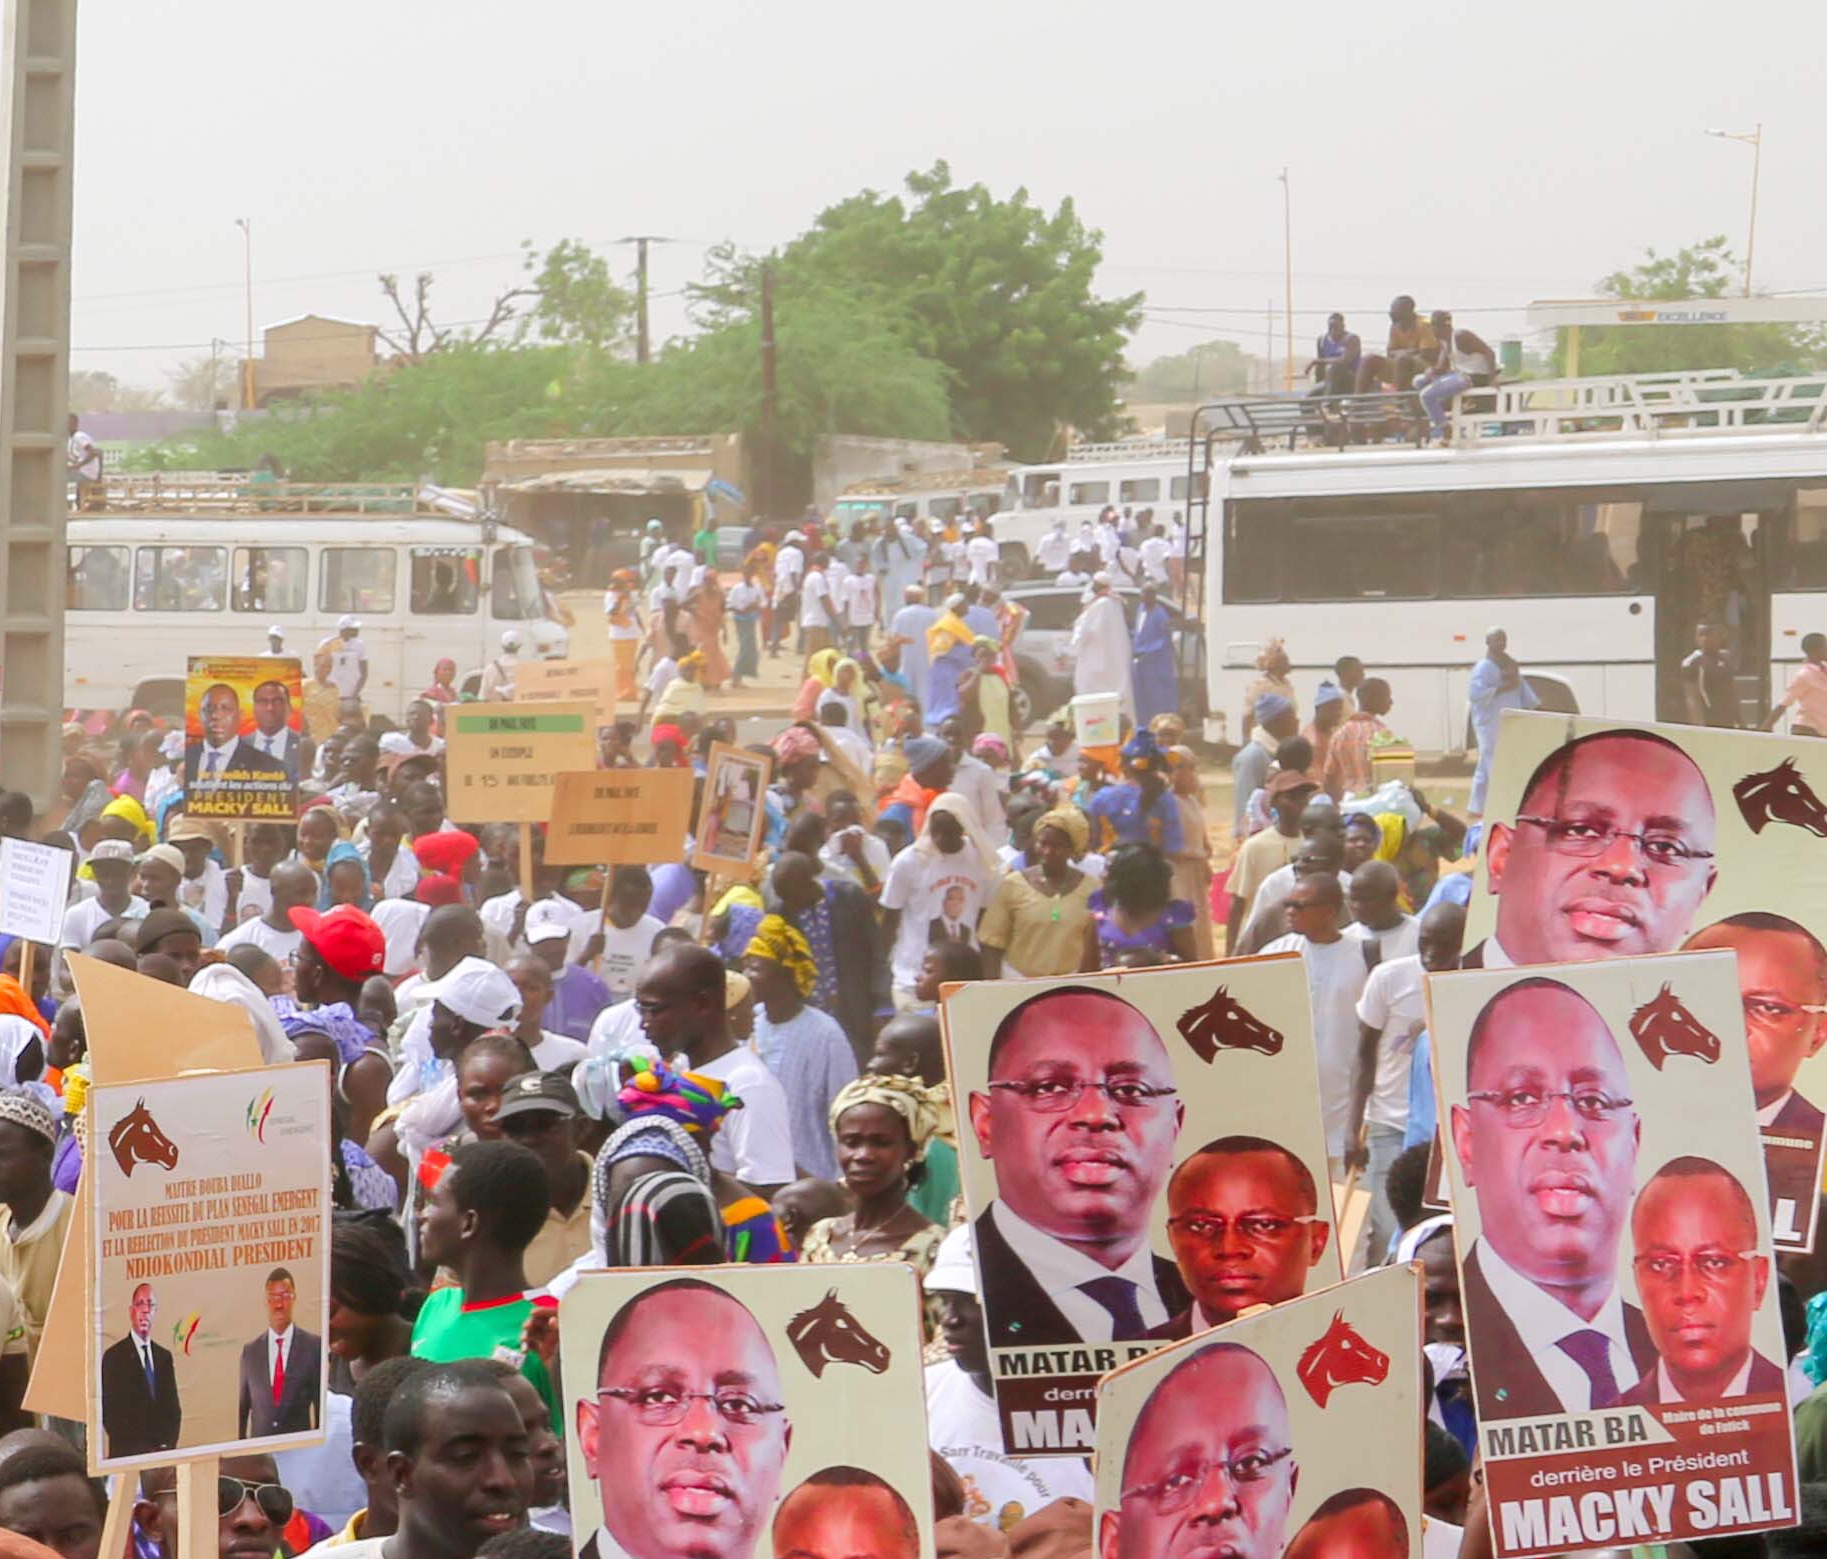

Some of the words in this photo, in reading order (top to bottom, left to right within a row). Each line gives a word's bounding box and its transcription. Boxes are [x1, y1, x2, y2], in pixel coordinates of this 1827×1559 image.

[187, 801, 248, 816] MACKY
[250, 801, 294, 816] SALL
[231, 1173, 263, 1192] DIALLO
[109, 1209, 135, 1232] POUR
[136, 1208, 150, 1229] LA
[206, 1197, 231, 1220] PLAN
[271, 1187, 319, 1212] EMERGENT
[189, 1224, 235, 1247] PRESIDENT
[236, 1220, 265, 1242] MACKY
[266, 1218, 288, 1238] SALL
[125, 1246, 228, 1281] NDIOKONDIAL
[232, 1237, 314, 1267] PRESIDENT
[998, 1349, 1117, 1376] MATAR
[1662, 1409, 1696, 1425] Maire
[1696, 1408, 1711, 1422] de
[1711, 1407, 1726, 1420] la
[1727, 1401, 1783, 1418] commune
[1699, 1422, 1715, 1436] de
[1715, 1419, 1751, 1434] Fatick
[1487, 1418, 1596, 1458] MATAR
[1603, 1413, 1649, 1444] BA
[1529, 1463, 1618, 1489] derrière
[1621, 1458, 1643, 1479] le
[1647, 1448, 1751, 1475] Président
[1499, 1483, 1677, 1552] MACKY
[1684, 1471, 1794, 1532] SALL
